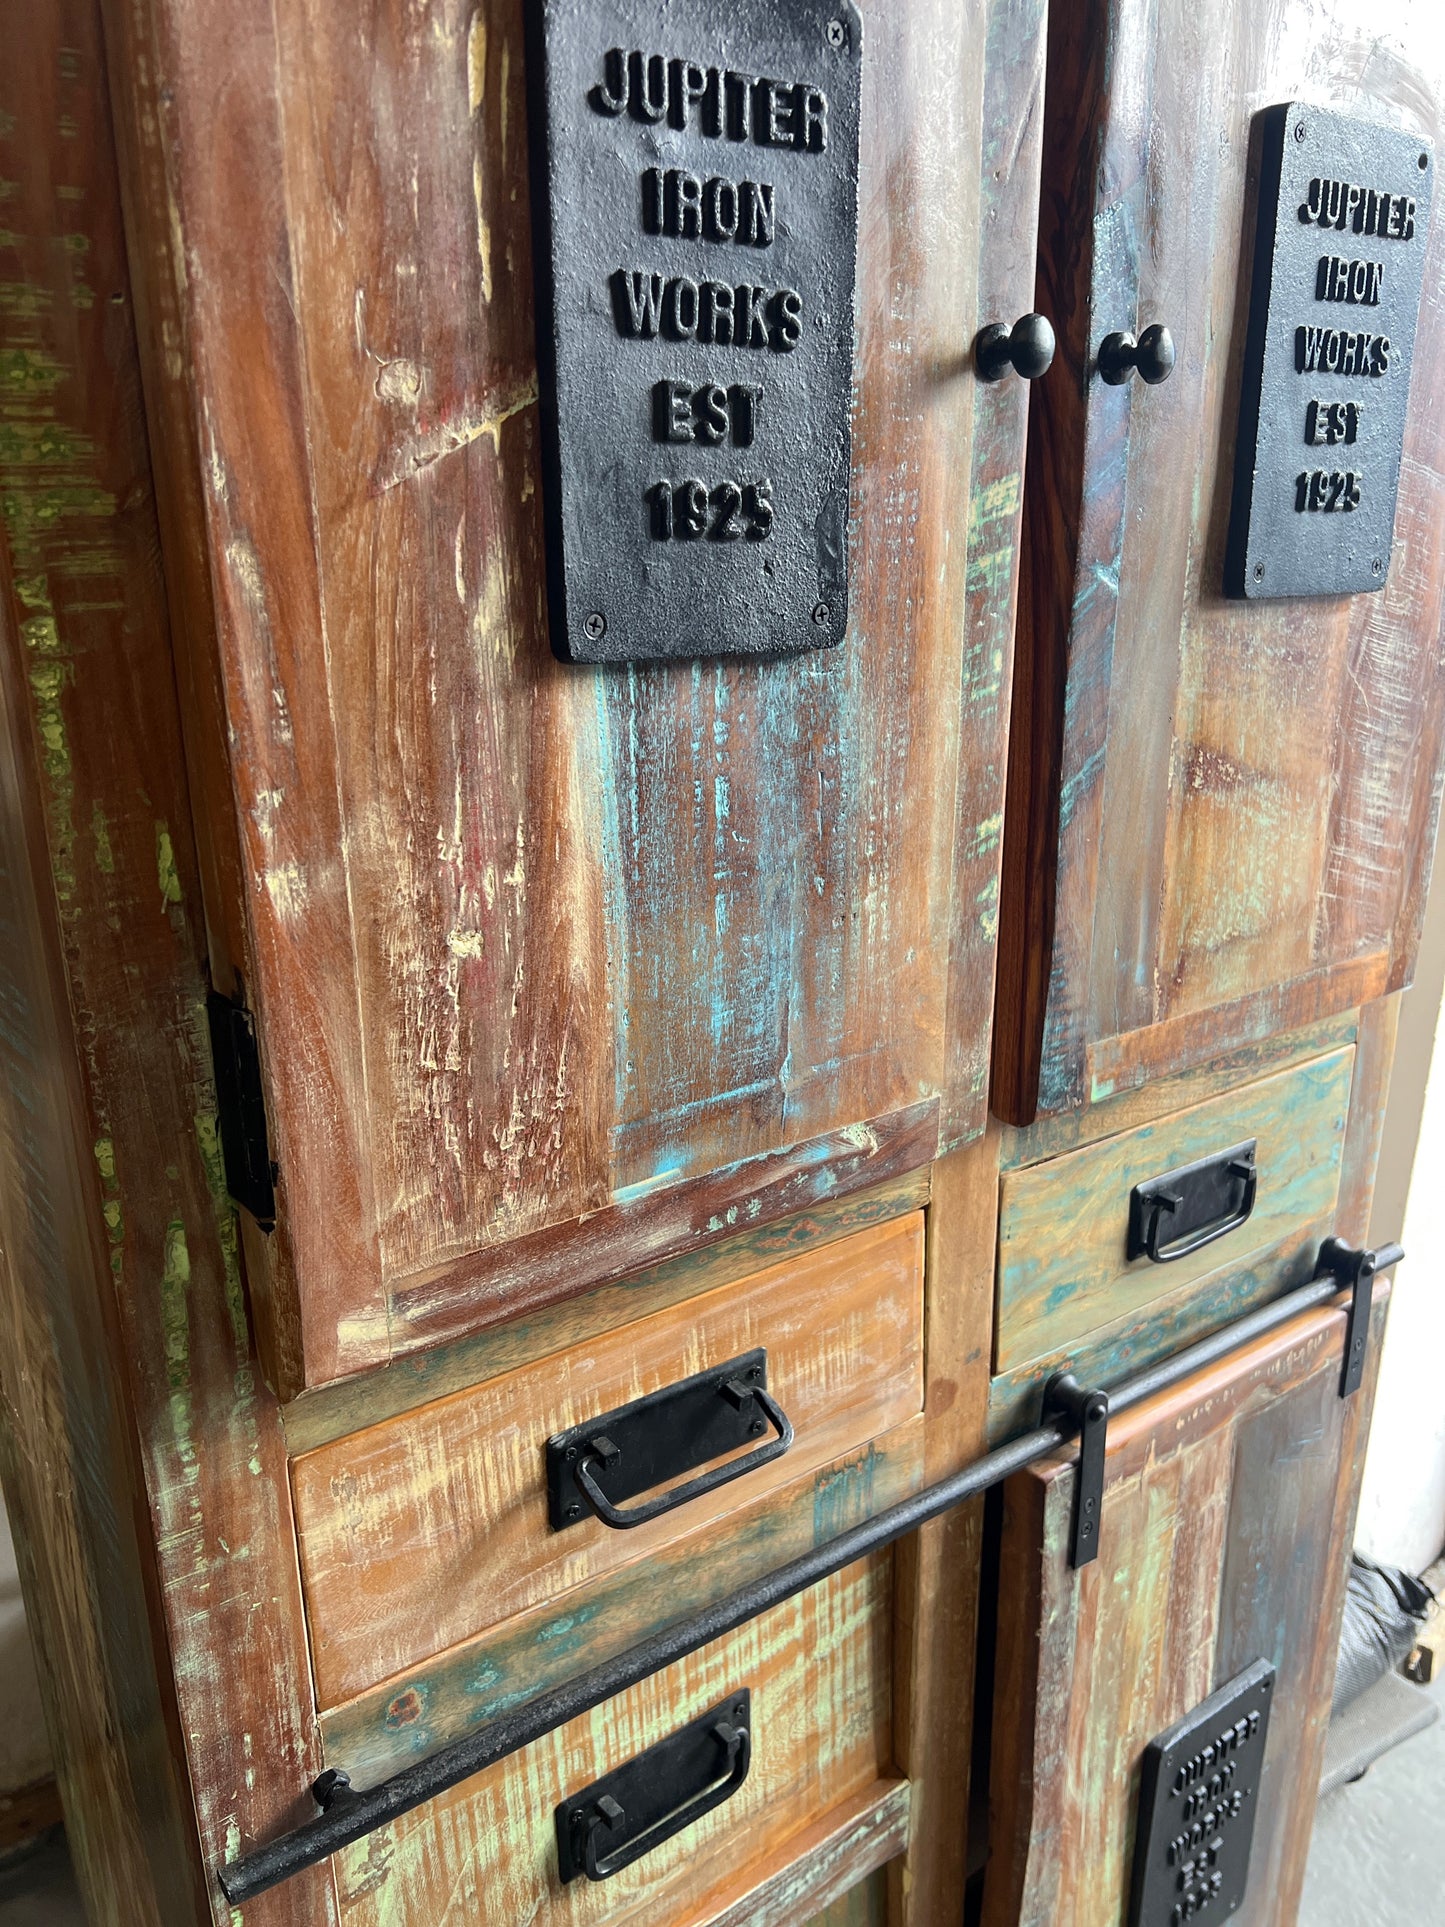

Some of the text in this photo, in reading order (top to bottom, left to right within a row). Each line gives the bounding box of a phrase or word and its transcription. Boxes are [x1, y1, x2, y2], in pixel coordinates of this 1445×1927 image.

[587, 48, 829, 153] JUPITER
[641, 167, 775, 248] IRON
[1298, 177, 1416, 241] JUPITER
[610, 268, 803, 353] WORKS
[1315, 255, 1385, 306] IRON
[1295, 325, 1390, 376] WORKS
[652, 378, 764, 447] EST
[1304, 399, 1364, 445] EST
[645, 479, 774, 541] 1925
[1295, 470, 1362, 513] 1925
